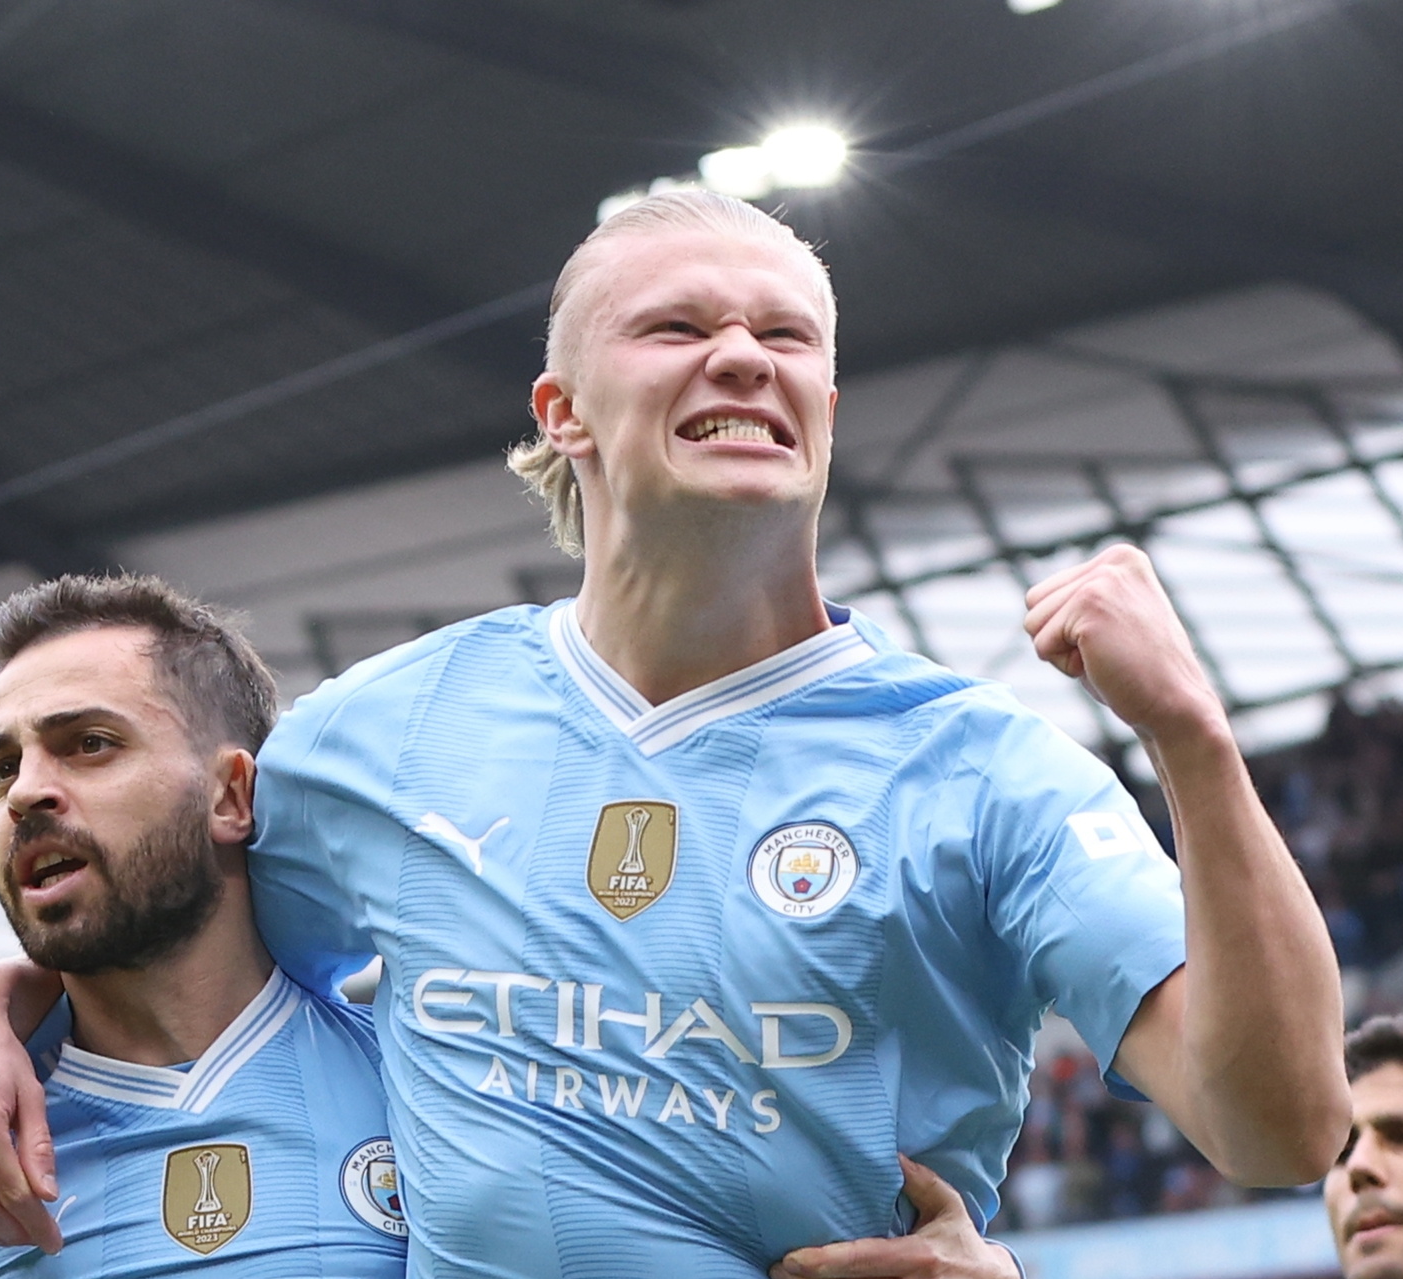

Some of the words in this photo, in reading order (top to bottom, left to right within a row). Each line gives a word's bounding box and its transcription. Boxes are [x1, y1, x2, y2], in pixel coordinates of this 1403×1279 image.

[763, 828, 850, 859] MANCHESTER
[608, 875, 648, 891] FIFA
[613, 897, 637, 907] 2023
[783, 903, 816, 915] CITY
[411, 966, 854, 1070] ETIHAD
[475, 1056, 783, 1136] AIRWAYS
[351, 1143, 396, 1172] MANCH
[187, 1213, 229, 1231] FIFA
[194, 1233, 219, 1245] 2023
